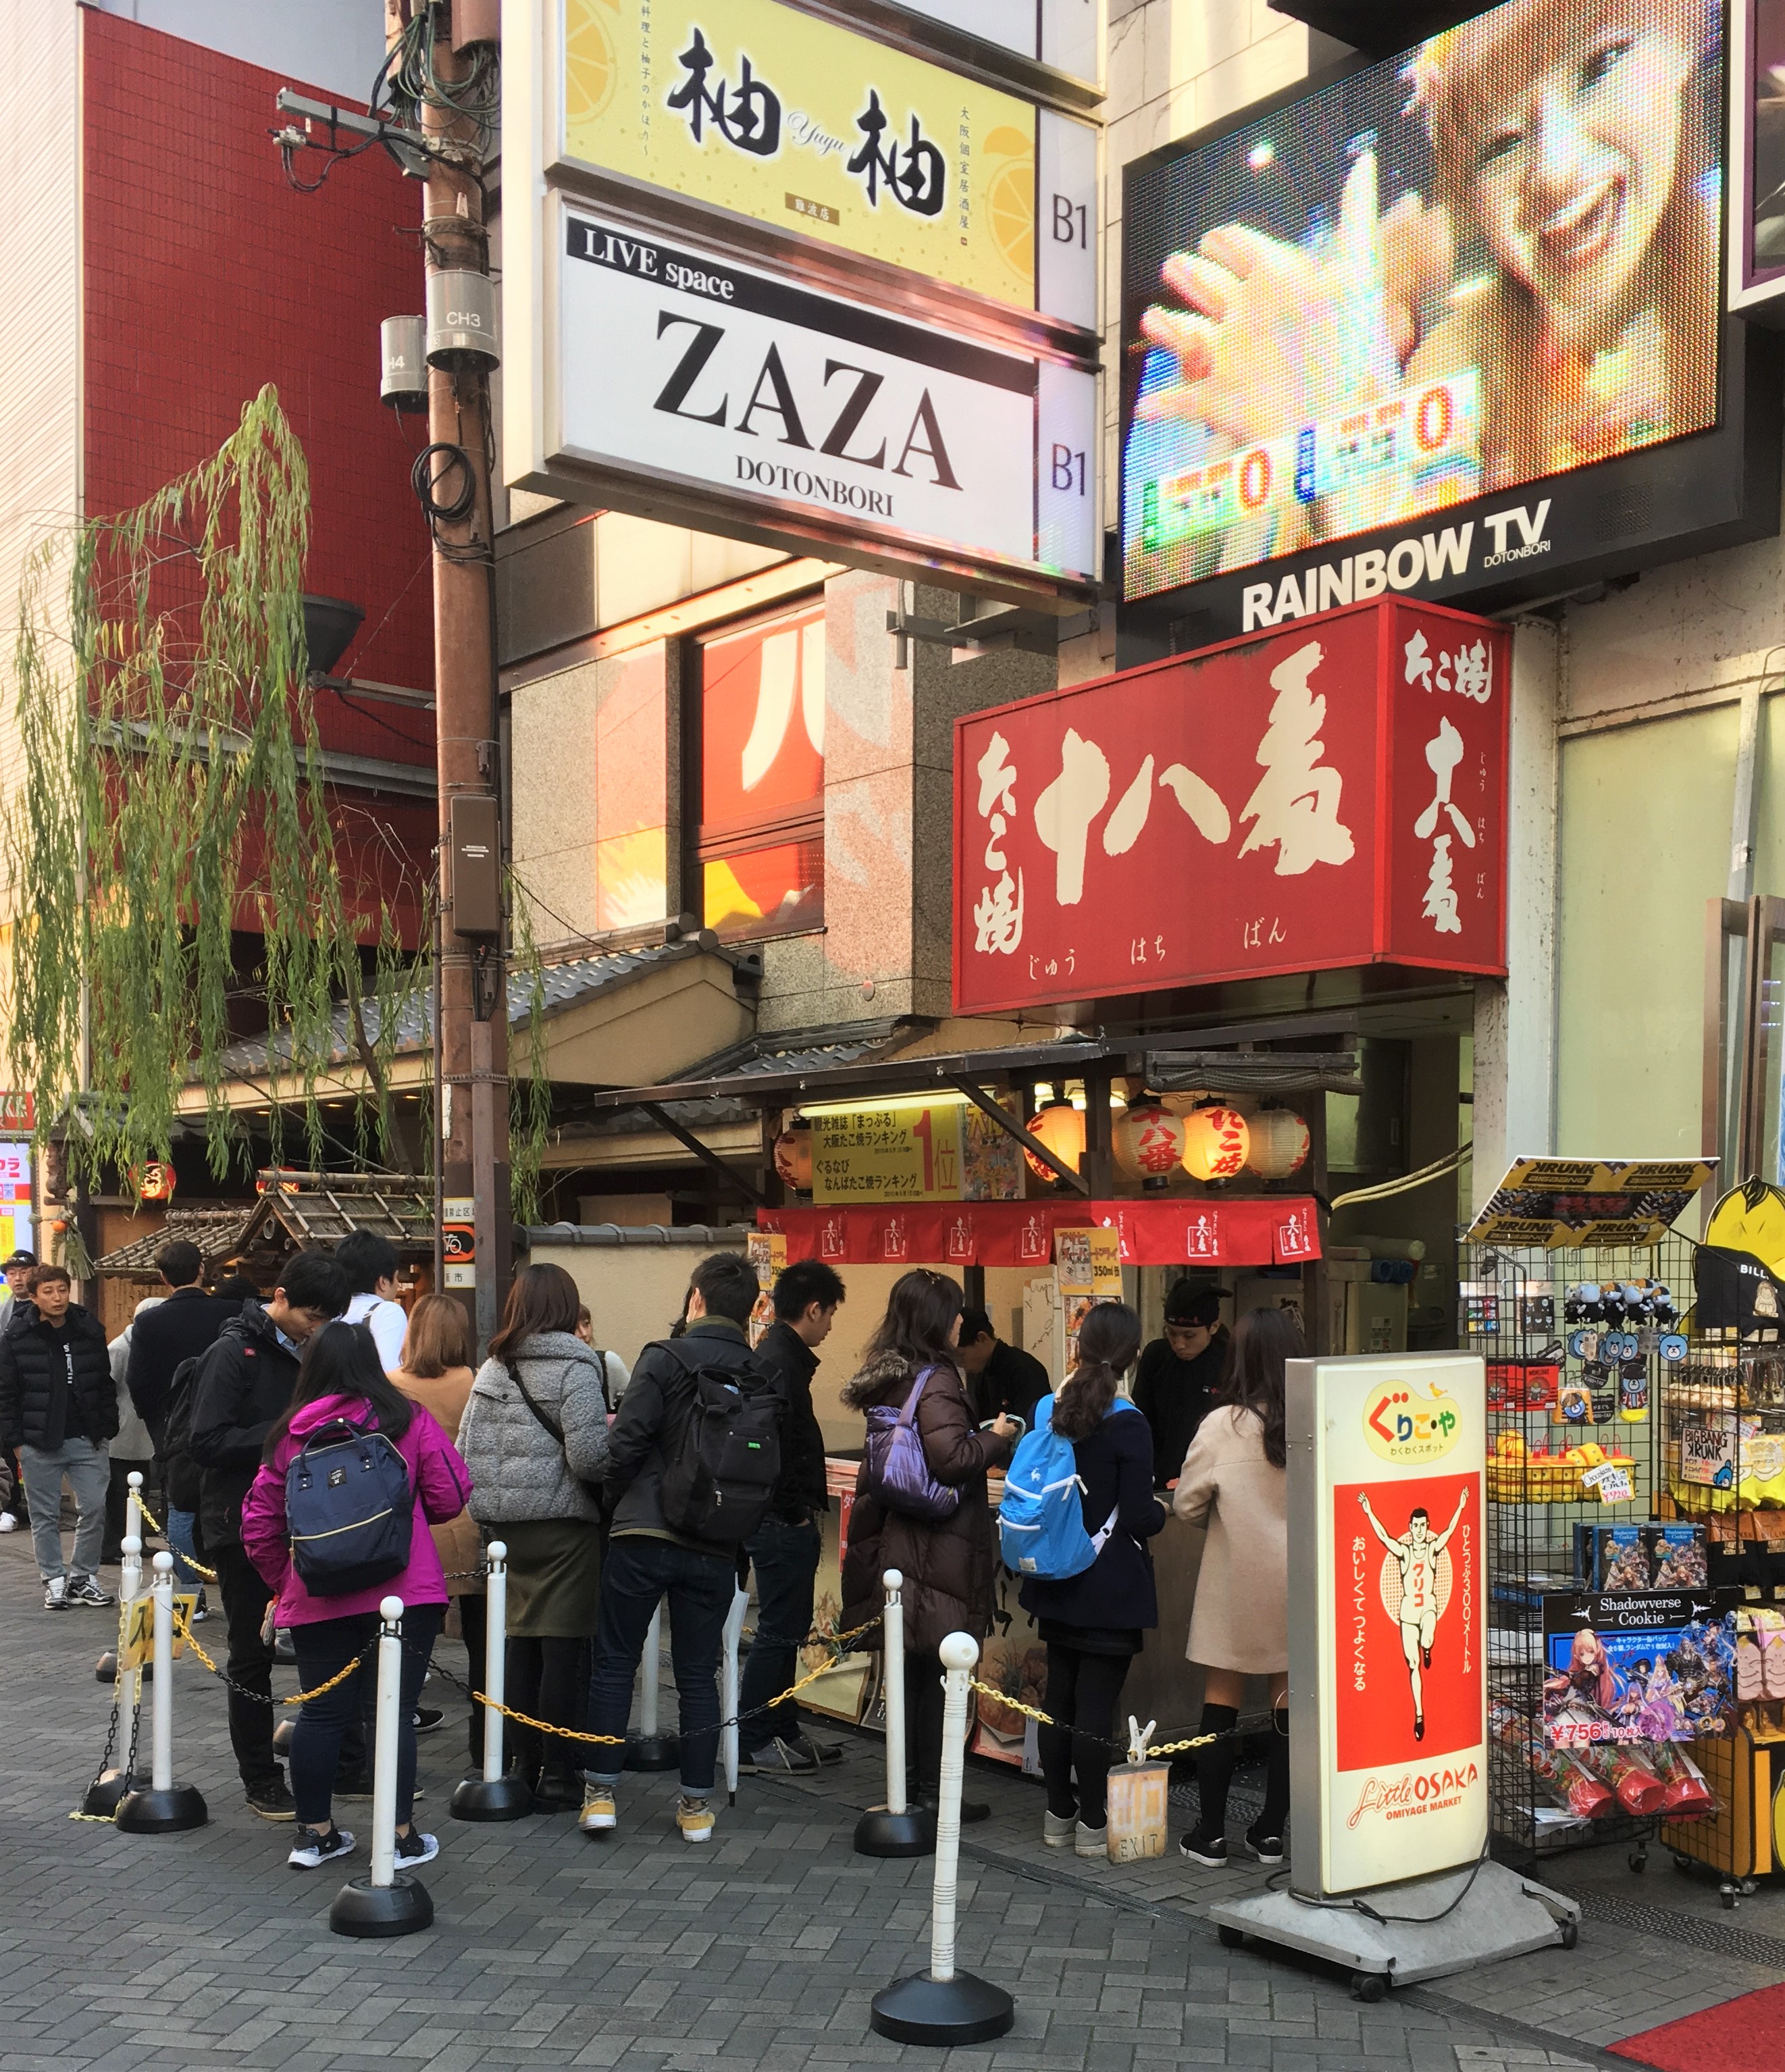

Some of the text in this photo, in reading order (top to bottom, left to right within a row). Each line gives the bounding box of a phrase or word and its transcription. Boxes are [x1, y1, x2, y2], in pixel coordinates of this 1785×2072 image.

[959, 106, 970, 229] 大阪個室居酒屋
[1053, 192, 1088, 251] B1
[584, 228, 735, 301] LIVE space
[446, 311, 481, 328] CH3
[652, 309, 965, 492] ZAZA
[734, 454, 895, 519] DOTONBORI
[1052, 442, 1087, 496] B1
[1242, 499, 1553, 633] RAINBOW TV
[1484, 540, 1551, 569] DOTONBORI
[1390, 1443, 1444, 1455] わくわくスポット
[1412, 1559, 1425, 1609] グリコ
[1600, 1597, 1682, 1611] Shadowverse
[1353, 1535, 1366, 1692] おいしくてつよくなる
[1618, 1611, 1665, 1626] Cookie
[1551, 1723, 1603, 1742] ¥756
[1348, 1763, 1478, 1828] Little OSAKA
[1386, 1795, 1463, 1821] OMIYAGE MARKET
[1119, 1834, 1158, 1857] EXIT
